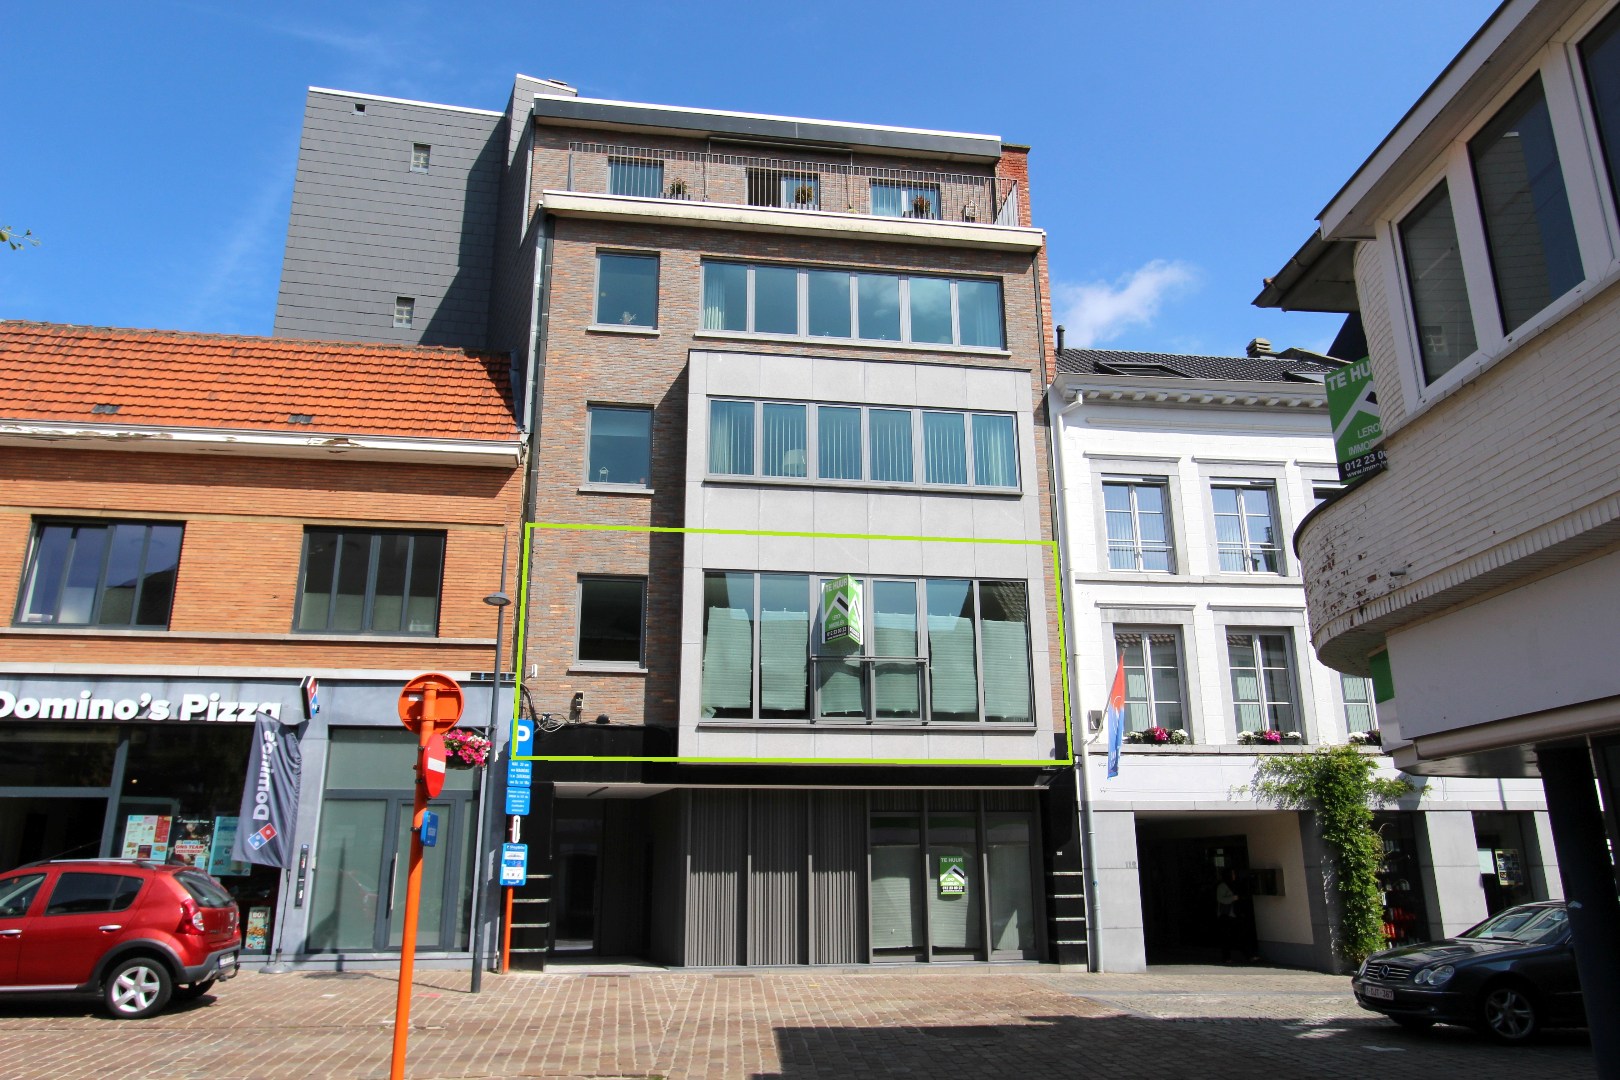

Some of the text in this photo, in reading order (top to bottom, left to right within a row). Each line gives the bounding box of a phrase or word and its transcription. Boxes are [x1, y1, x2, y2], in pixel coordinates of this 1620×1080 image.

[1326, 371, 1347, 391] TE
[1344, 458, 1362, 471] 012
[1363, 453, 1376, 465] 23
[825, 584, 833, 592] TE
[179, 692, 282, 722] Pizza
[252, 730, 278, 821] Domino's
